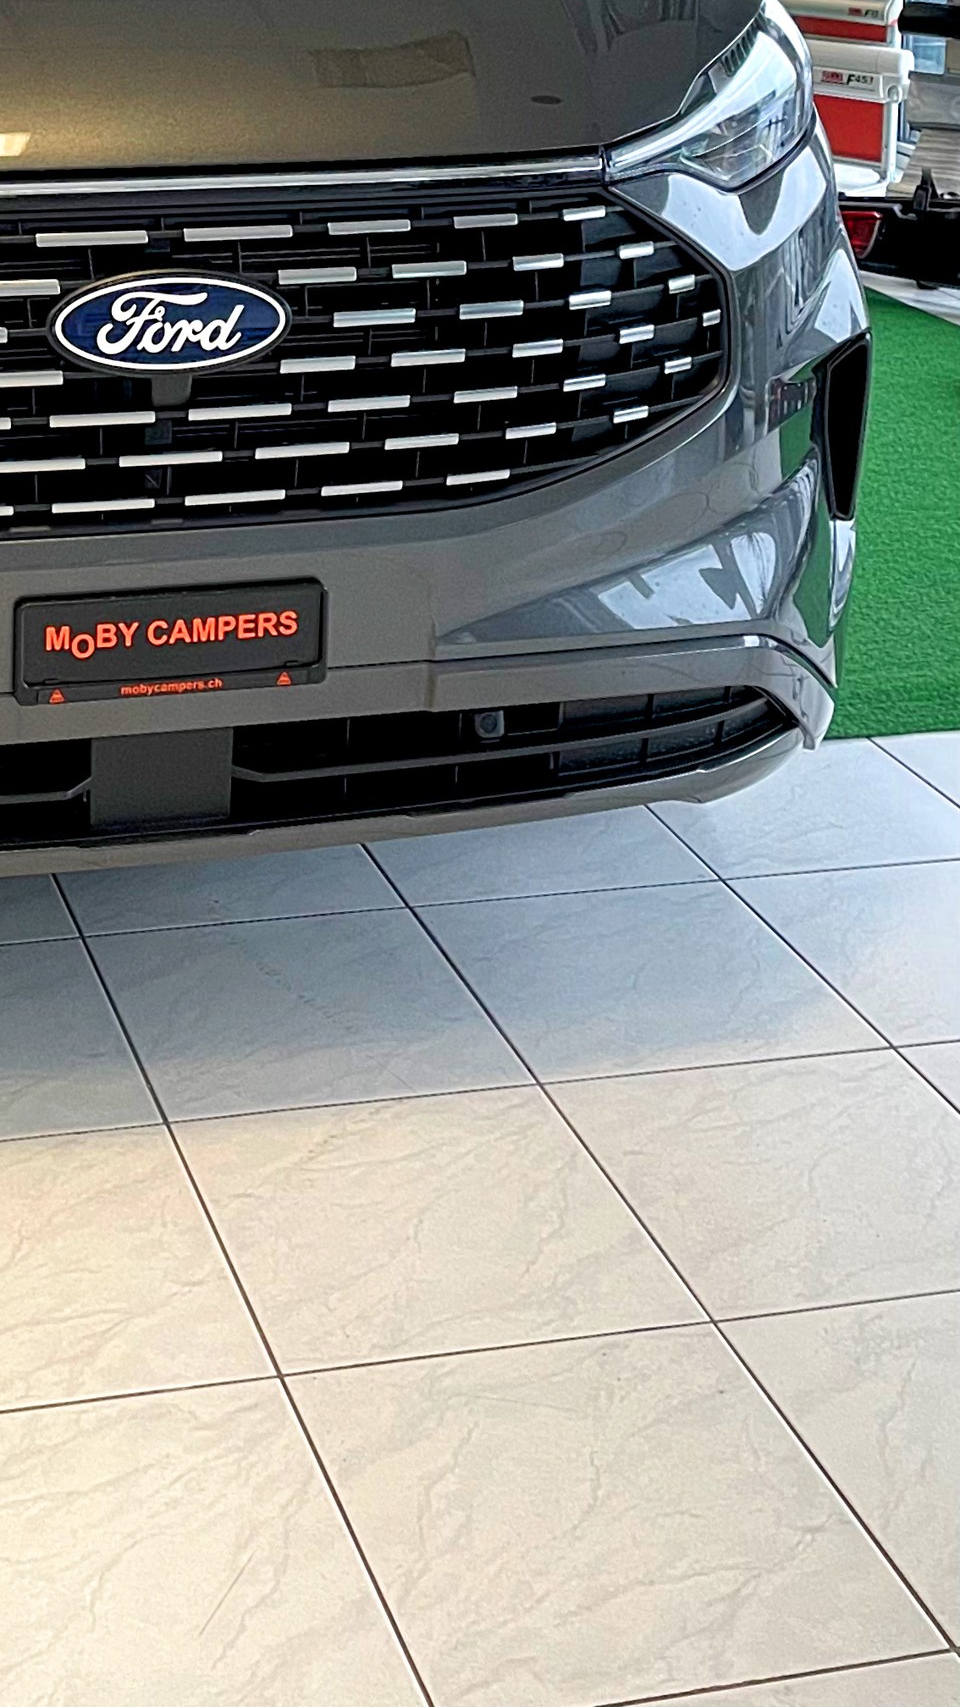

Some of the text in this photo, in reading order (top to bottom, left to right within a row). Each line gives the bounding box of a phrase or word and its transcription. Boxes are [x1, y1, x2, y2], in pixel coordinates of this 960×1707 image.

[96, 291, 245, 355] Ford
[146, 610, 299, 646] CAMPERS
[120, 677, 223, 696] mobycampers.ch
